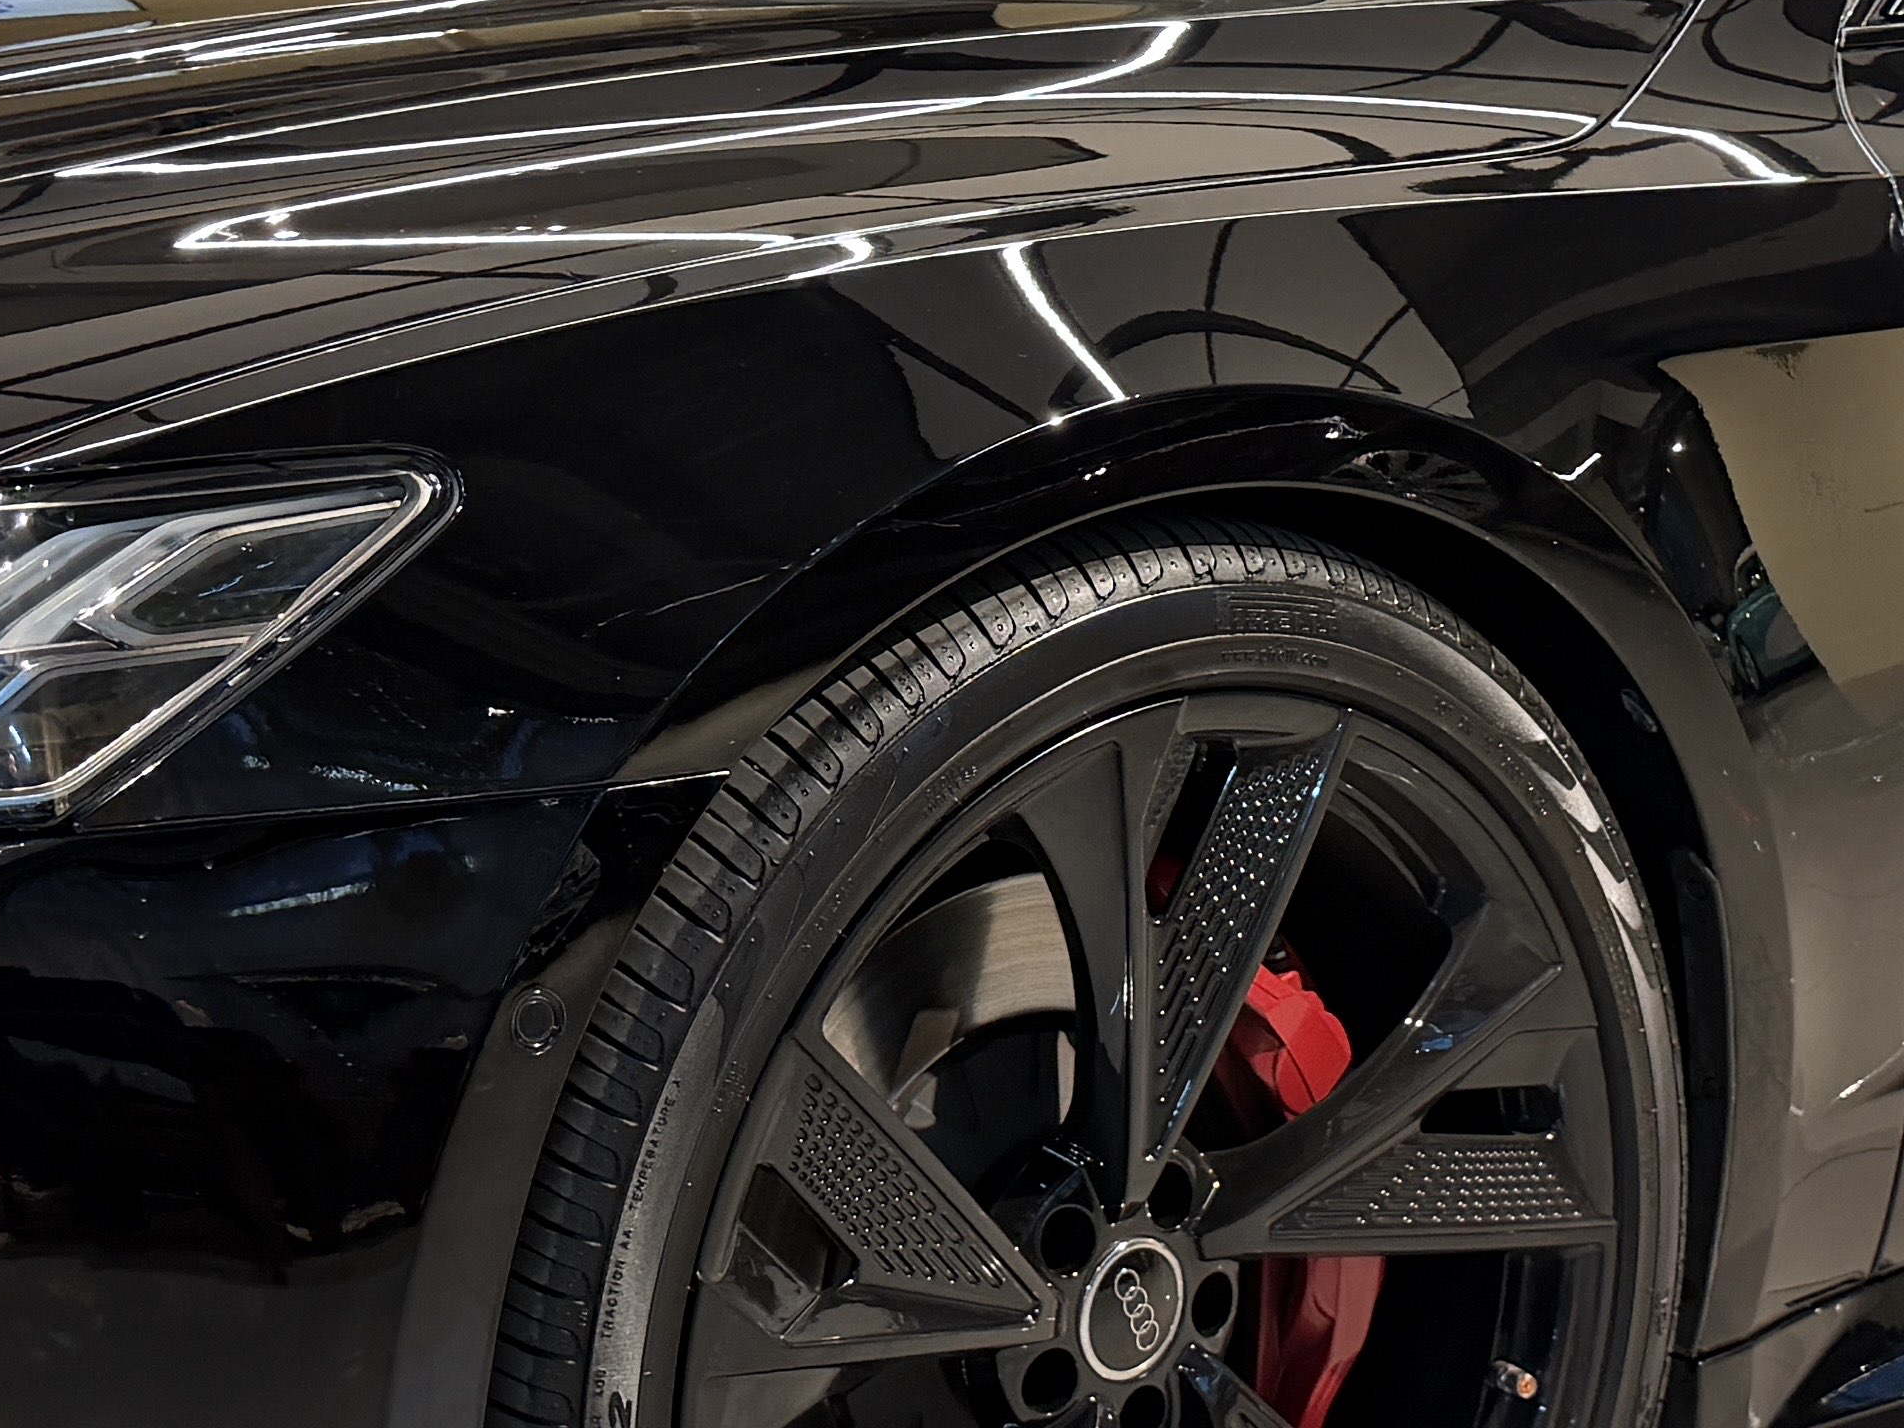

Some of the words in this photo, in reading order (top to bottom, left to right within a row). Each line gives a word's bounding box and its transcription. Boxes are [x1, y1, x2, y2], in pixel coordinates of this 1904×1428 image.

[599, 1260, 626, 1340] TRACTION
[620, 1227, 634, 1251] AA
[628, 1096, 677, 1213] TEMPERATURE
